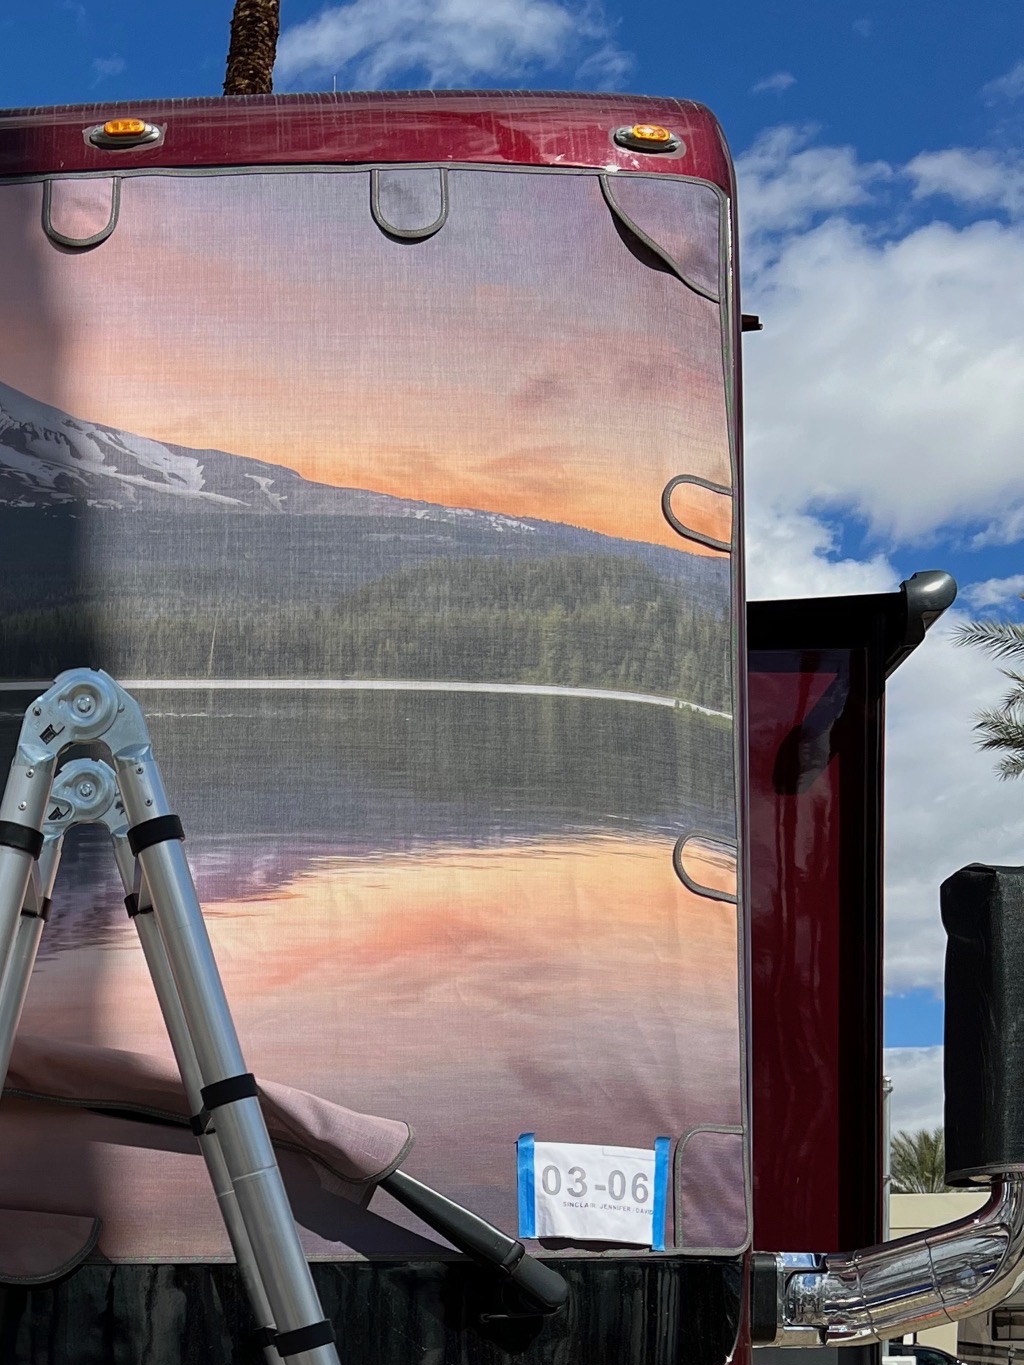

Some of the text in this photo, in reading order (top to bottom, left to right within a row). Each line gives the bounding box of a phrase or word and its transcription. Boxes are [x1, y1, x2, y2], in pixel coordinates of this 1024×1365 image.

[542, 1165, 649, 1204] 03-06
[562, 1201, 596, 1209] SINCLAIR
[599, 1203, 631, 1212] JENNIFER
